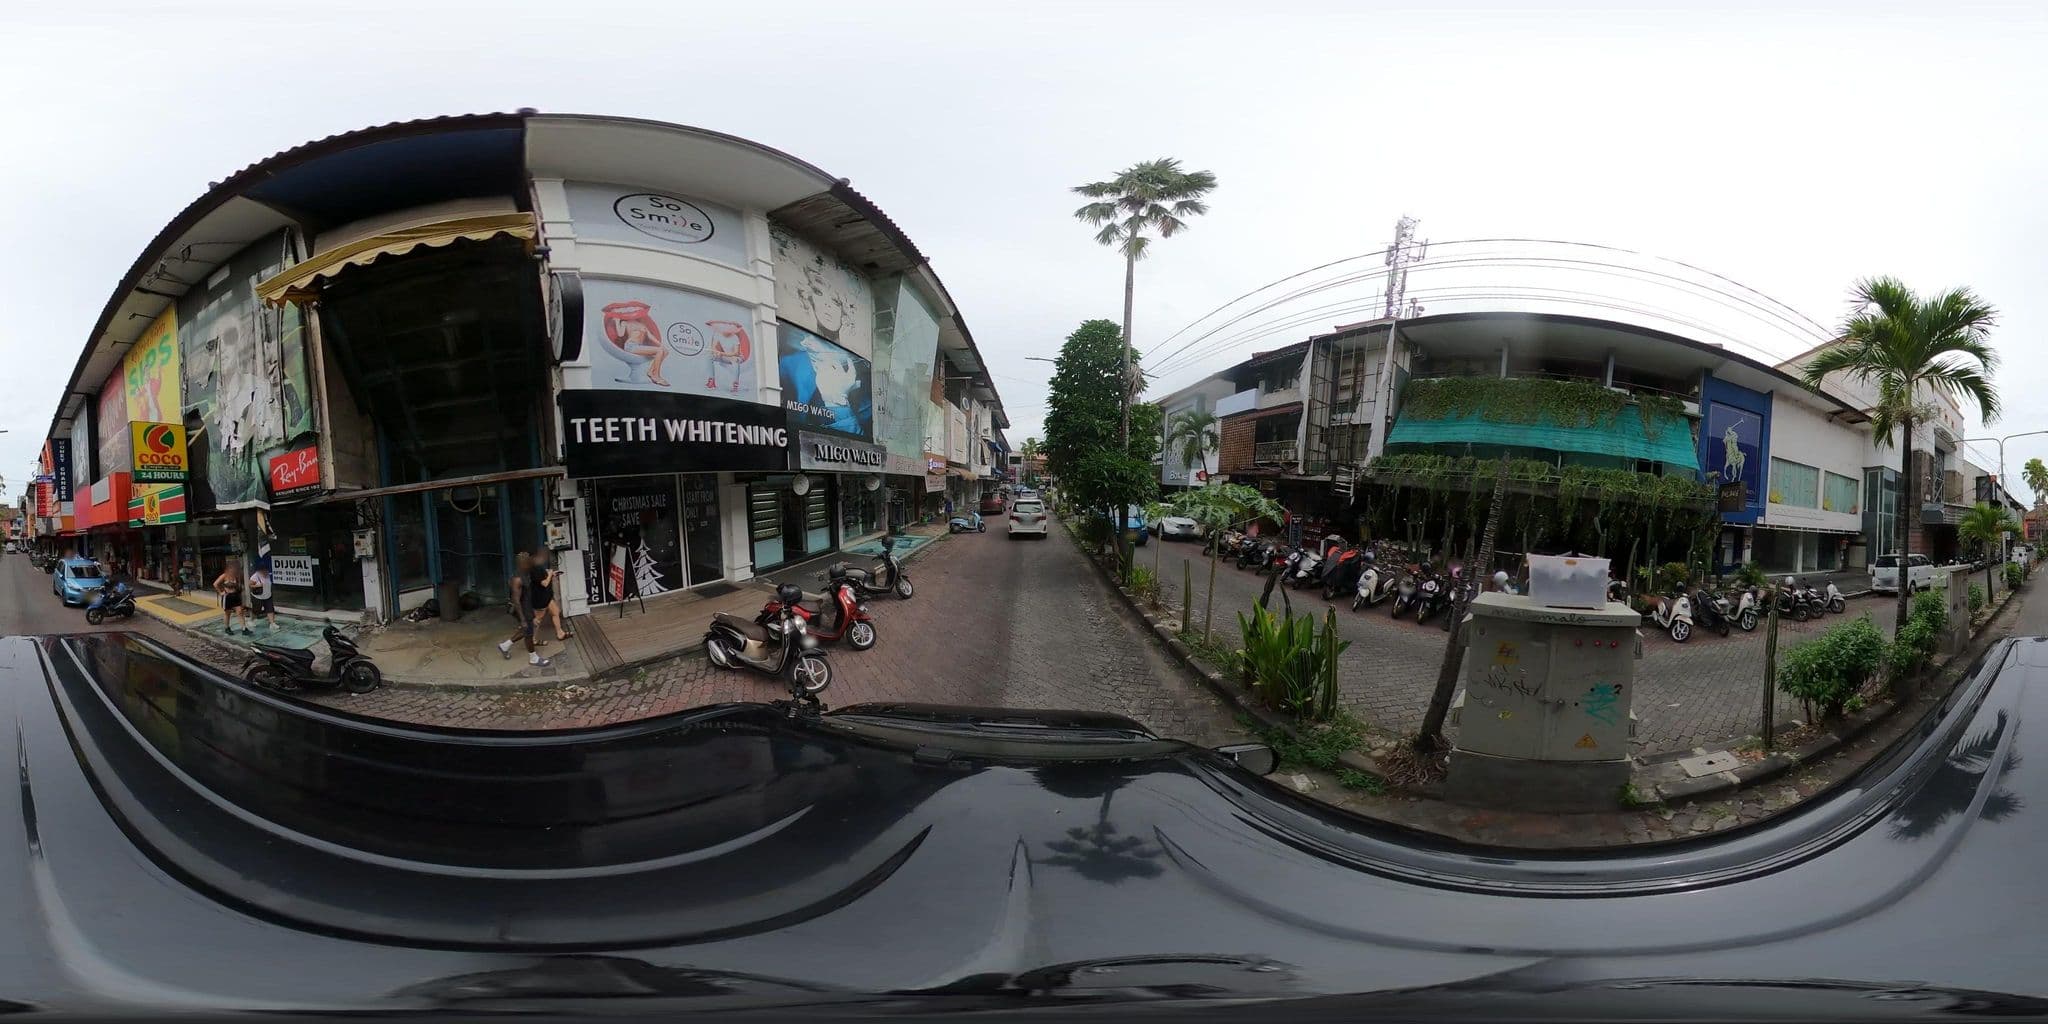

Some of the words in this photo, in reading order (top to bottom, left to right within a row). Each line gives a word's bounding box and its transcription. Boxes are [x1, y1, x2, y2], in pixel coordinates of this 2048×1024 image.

[649, 197, 681, 212] So
[679, 325, 692, 335] So
[786, 400, 810, 413] MIGO
[810, 406, 836, 420] WATCH
[570, 417, 657, 443] TEETH
[663, 419, 789, 448] WHITENING
[139, 453, 182, 465] COCO
[815, 443, 850, 462] MIGO
[850, 447, 882, 466] WATCH
[141, 471, 153, 480] 24
[153, 471, 185, 480] HOURS
[273, 450, 318, 485] Ray-Ban
[612, 496, 649, 512] CHRISTMAS
[650, 494, 667, 508] SALE
[622, 511, 640, 528] SAVE
[274, 559, 309, 570] DIJUAL
[588, 527, 600, 602] WHITENING
